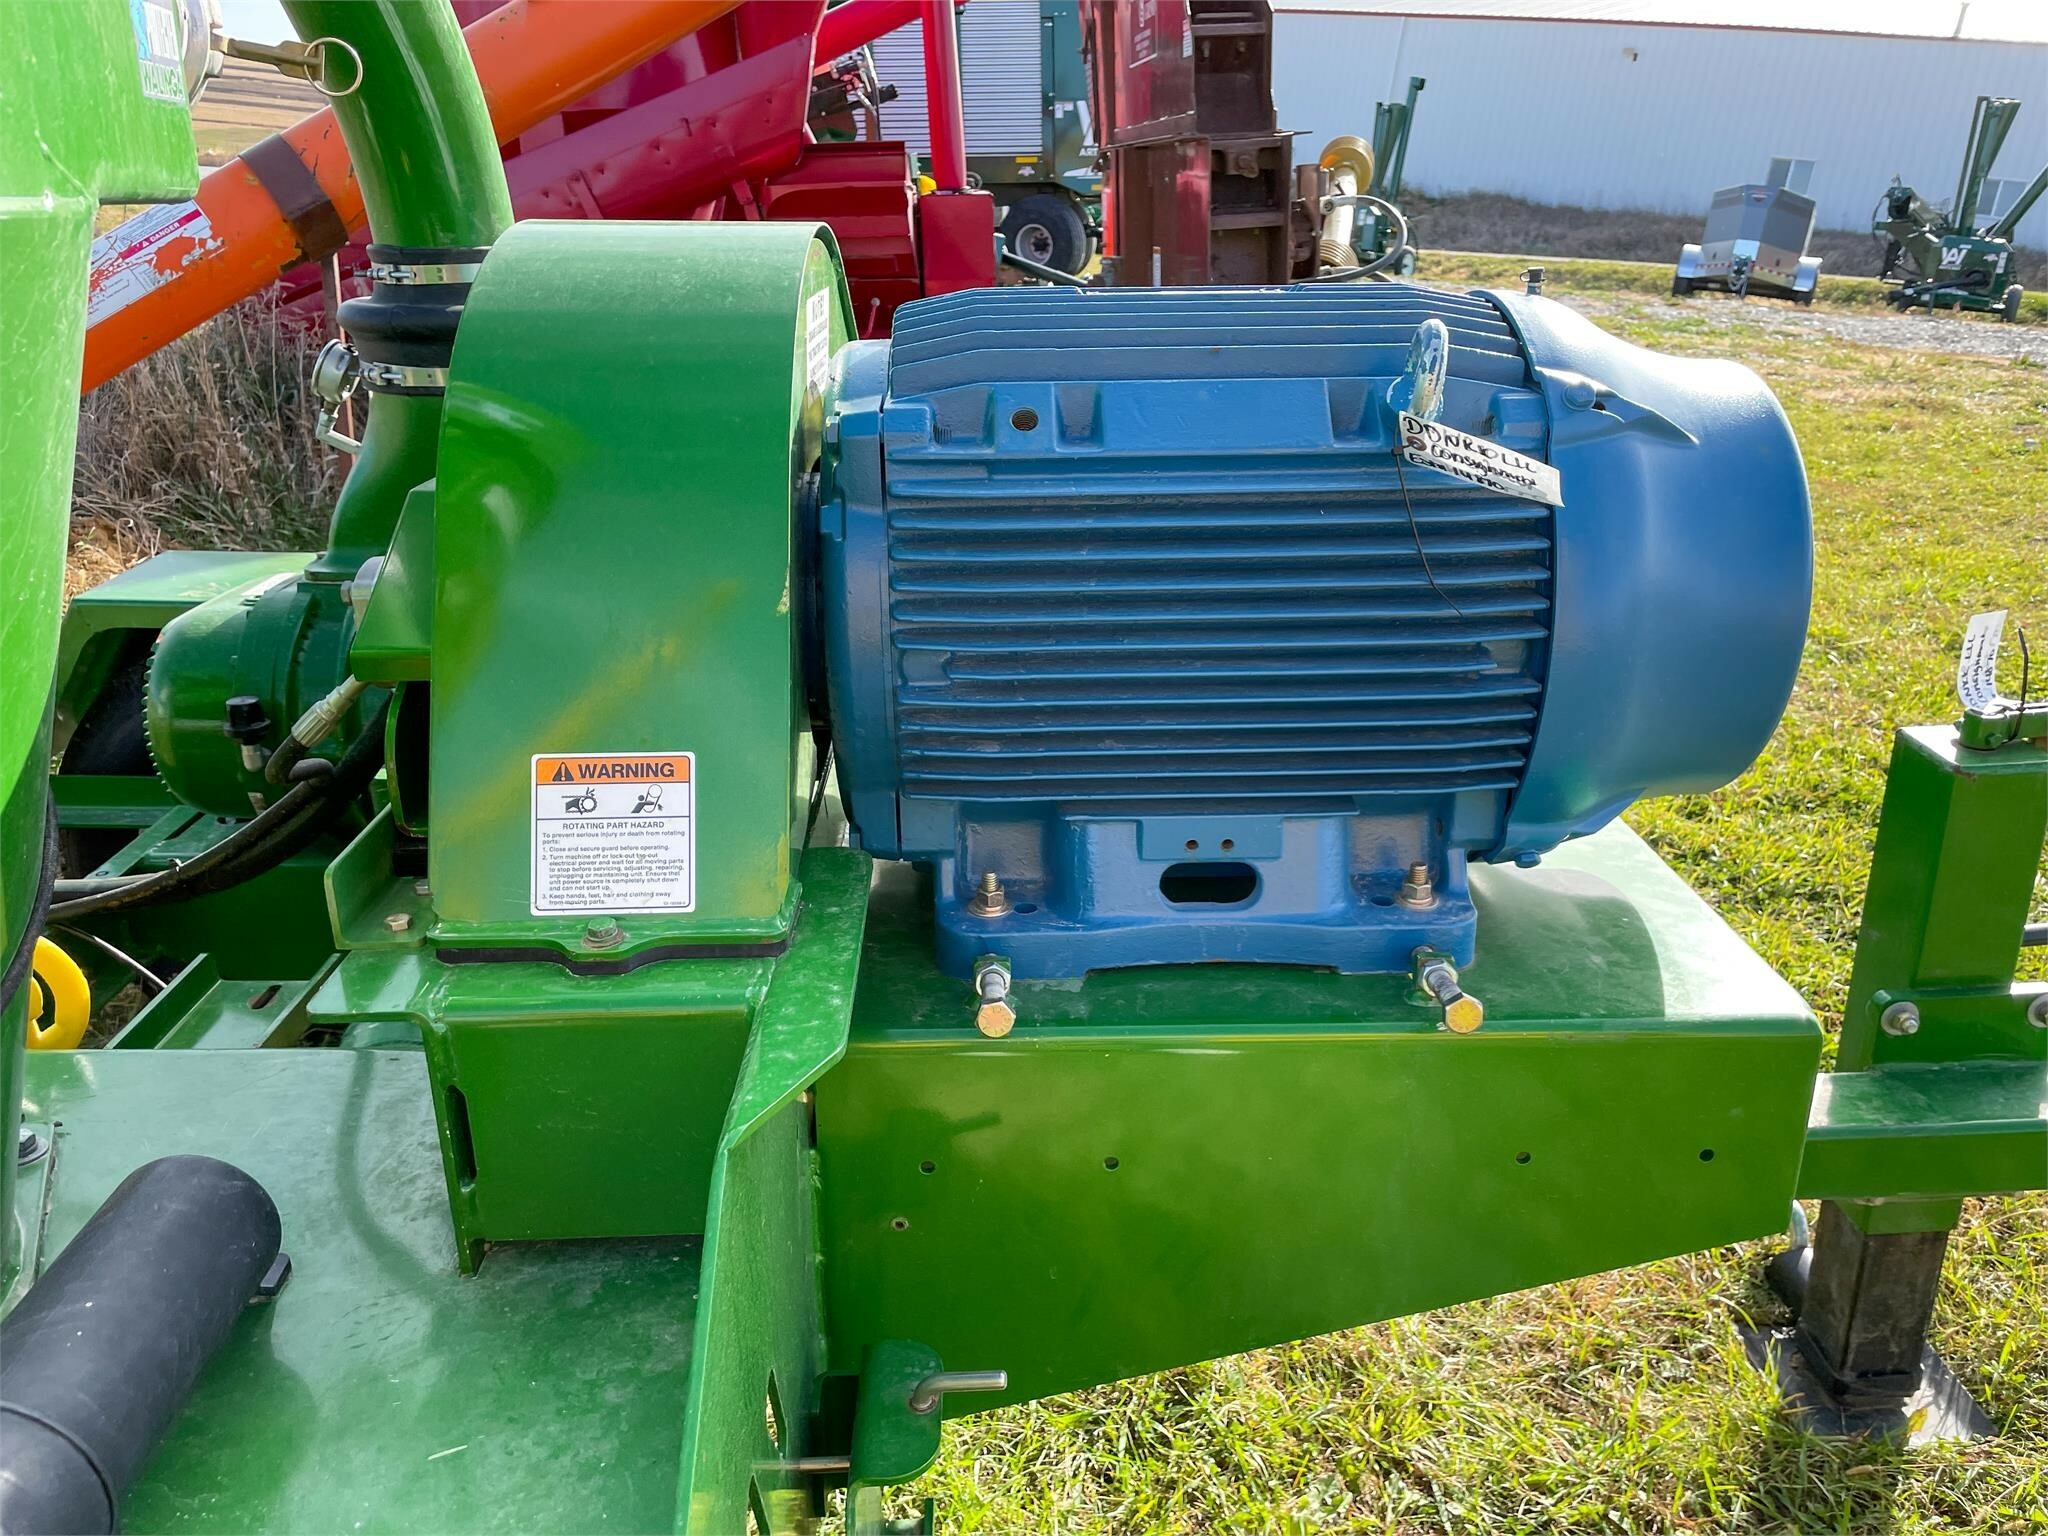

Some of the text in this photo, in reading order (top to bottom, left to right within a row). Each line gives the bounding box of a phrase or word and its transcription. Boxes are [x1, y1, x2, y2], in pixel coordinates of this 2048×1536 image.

[150, 222, 180, 242] DANGER
[578, 762, 674, 778] WARNING
[563, 822, 604, 830] ROTATING
[630, 821, 665, 829] HAZARD
